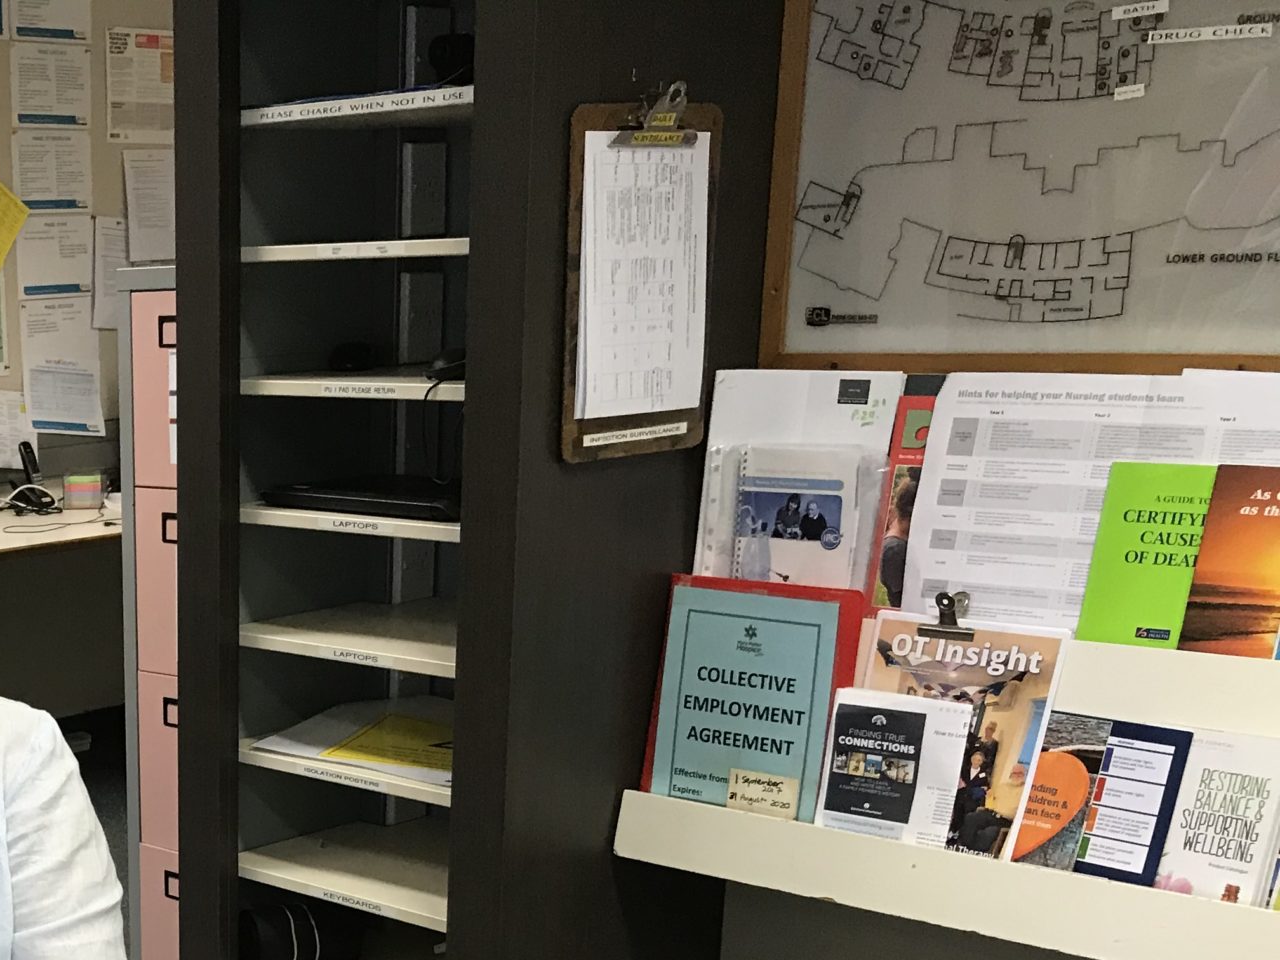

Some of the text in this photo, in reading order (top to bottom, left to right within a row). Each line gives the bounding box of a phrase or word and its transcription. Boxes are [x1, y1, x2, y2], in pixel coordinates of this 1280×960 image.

[1123, 4, 1155, 15] BATH
[1237, 13, 1280, 25] GROUN
[1151, 26, 1269, 42] DRUG CHECK
[260, 91, 465, 120] PLEASE CHARGE WHEN NOT IN USE
[1166, 252, 1280, 264] LOWER GROUND FL
[958, 389, 983, 399] Hints
[984, 389, 999, 399] for
[1001, 390, 1038, 402] helping
[1040, 392, 1063, 402] your
[1065, 392, 1105, 403] Nursing
[1107, 393, 1154, 403] students
[1154, 495, 1161, 503] A
[1163, 495, 1195, 504] GUIDE
[1250, 489, 1271, 500] As
[1123, 509, 1207, 527] CERTIFYI
[1240, 505, 1280, 516] as th
[332, 520, 379, 531] LAPTOPS
[1140, 530, 1202, 547] CAUSE
[1124, 550, 1197, 568] OF DEAT
[333, 650, 379, 663] LAPTOPS
[891, 633, 1043, 676] OT Insight
[697, 666, 797, 693] COLLECTIVE
[683, 694, 806, 726] EMPLOYMENT
[686, 726, 795, 756] AGREEMENT
[848, 727, 906, 743] FINDING TRUE
[838, 735, 915, 754] CONNECTIONS
[303, 767, 380, 788] ISOLATION POSTERS
[674, 767, 707, 780] Effective
[673, 784, 703, 796] Expires:
[1031, 784, 1058, 796] nding
[1199, 768, 1271, 800] RESTORING
[1061, 800, 1068, 809] &
[1194, 789, 1266, 821] BALANCE &
[1024, 808, 1061, 820] an face
[1180, 808, 1260, 842] SUPPORTING
[1183, 830, 1256, 863] WELLBEING
[322, 891, 382, 912] KEYBOARDS
